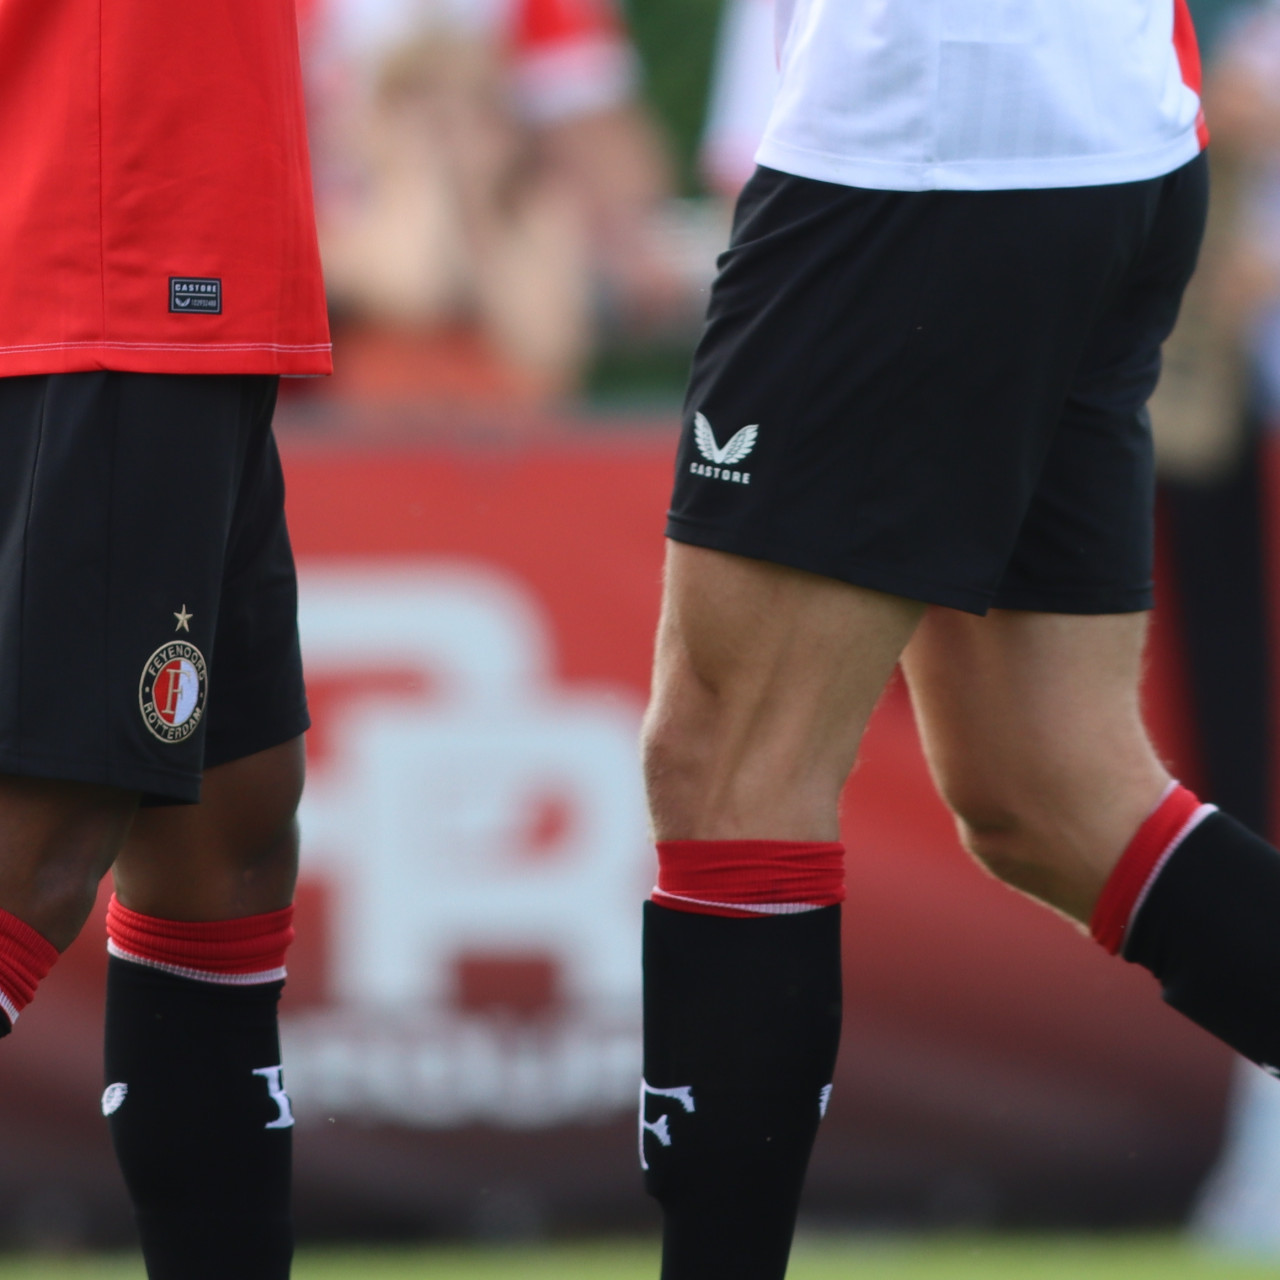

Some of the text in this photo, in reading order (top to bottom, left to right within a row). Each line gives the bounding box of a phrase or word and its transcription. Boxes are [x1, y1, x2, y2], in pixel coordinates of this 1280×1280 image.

[174, 283, 217, 293] CASTORE
[689, 462, 751, 485] CASTORE
[147, 644, 206, 681] FEYENOORD
[143, 701, 203, 740] ROTTERDAM
